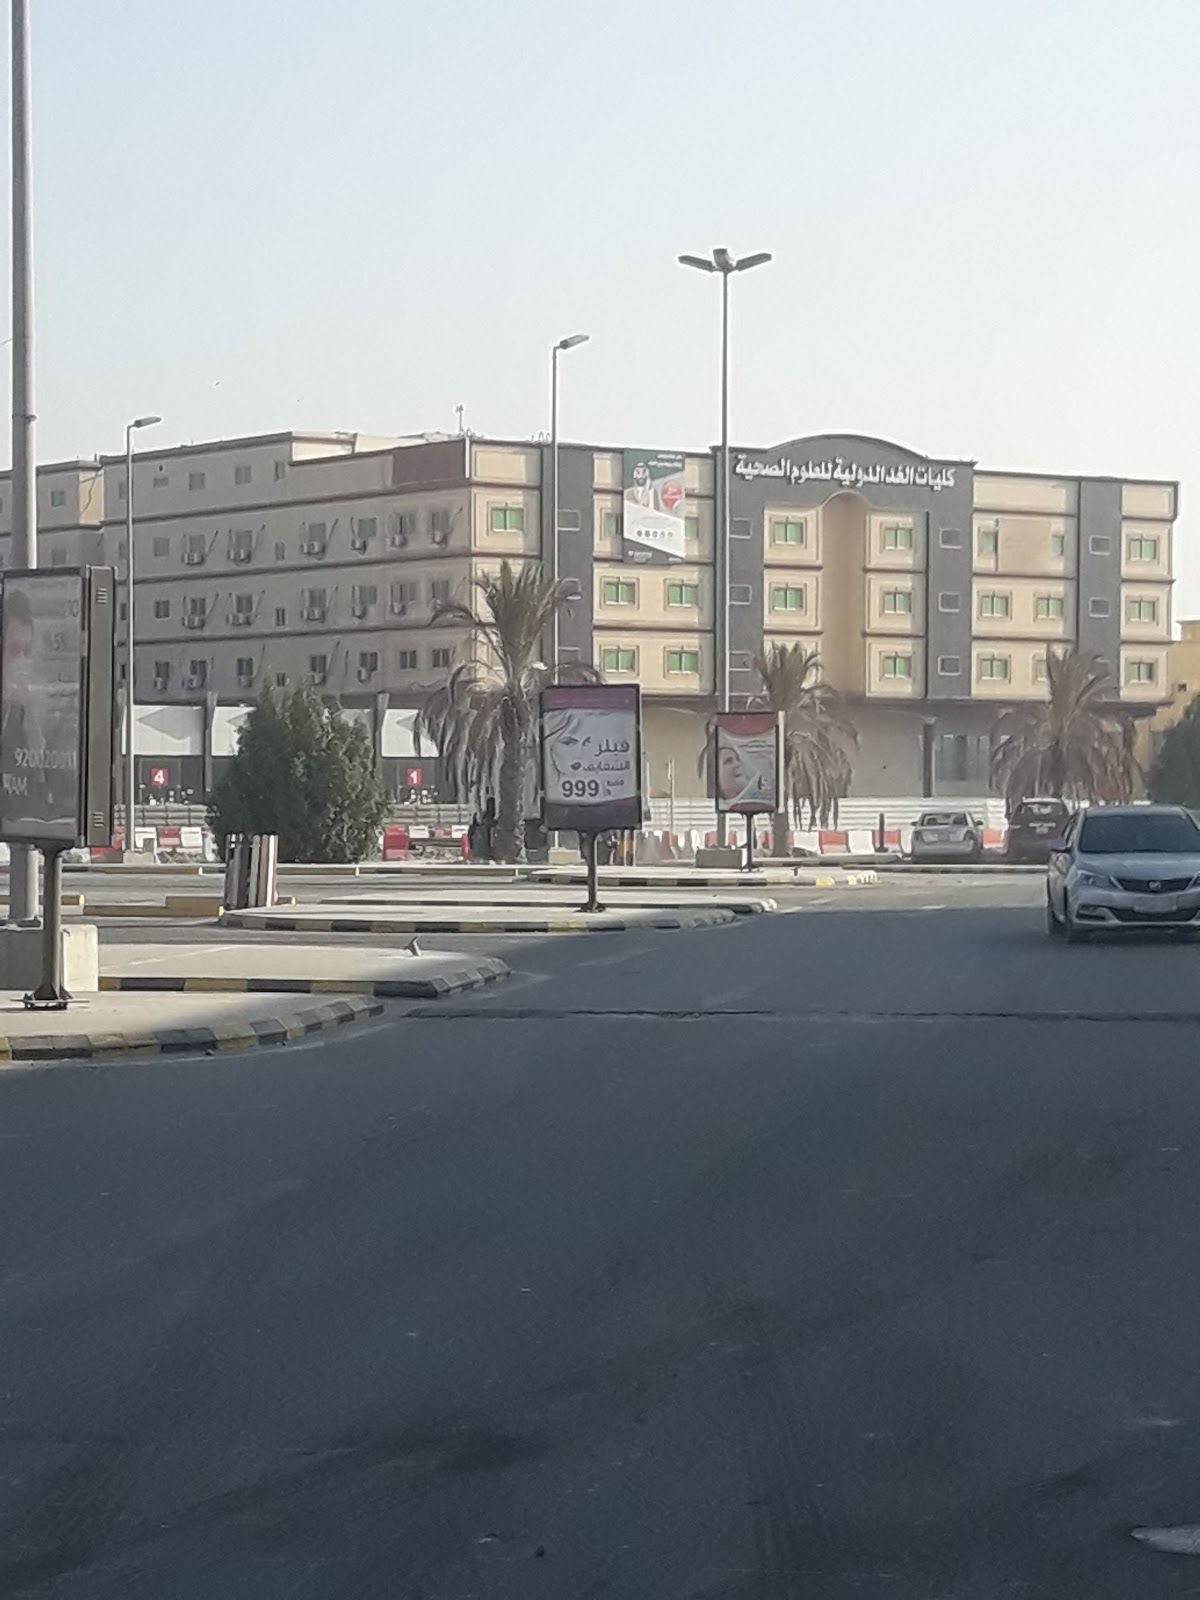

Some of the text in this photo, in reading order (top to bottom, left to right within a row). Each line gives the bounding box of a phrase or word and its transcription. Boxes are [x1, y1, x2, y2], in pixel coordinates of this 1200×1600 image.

[735, 453, 955, 491] كليات الغد الدولية للعلوم الصحية
[154, 769, 165, 784] 4
[409, 770, 418, 784] 1
[561, 779, 599, 798] 999
